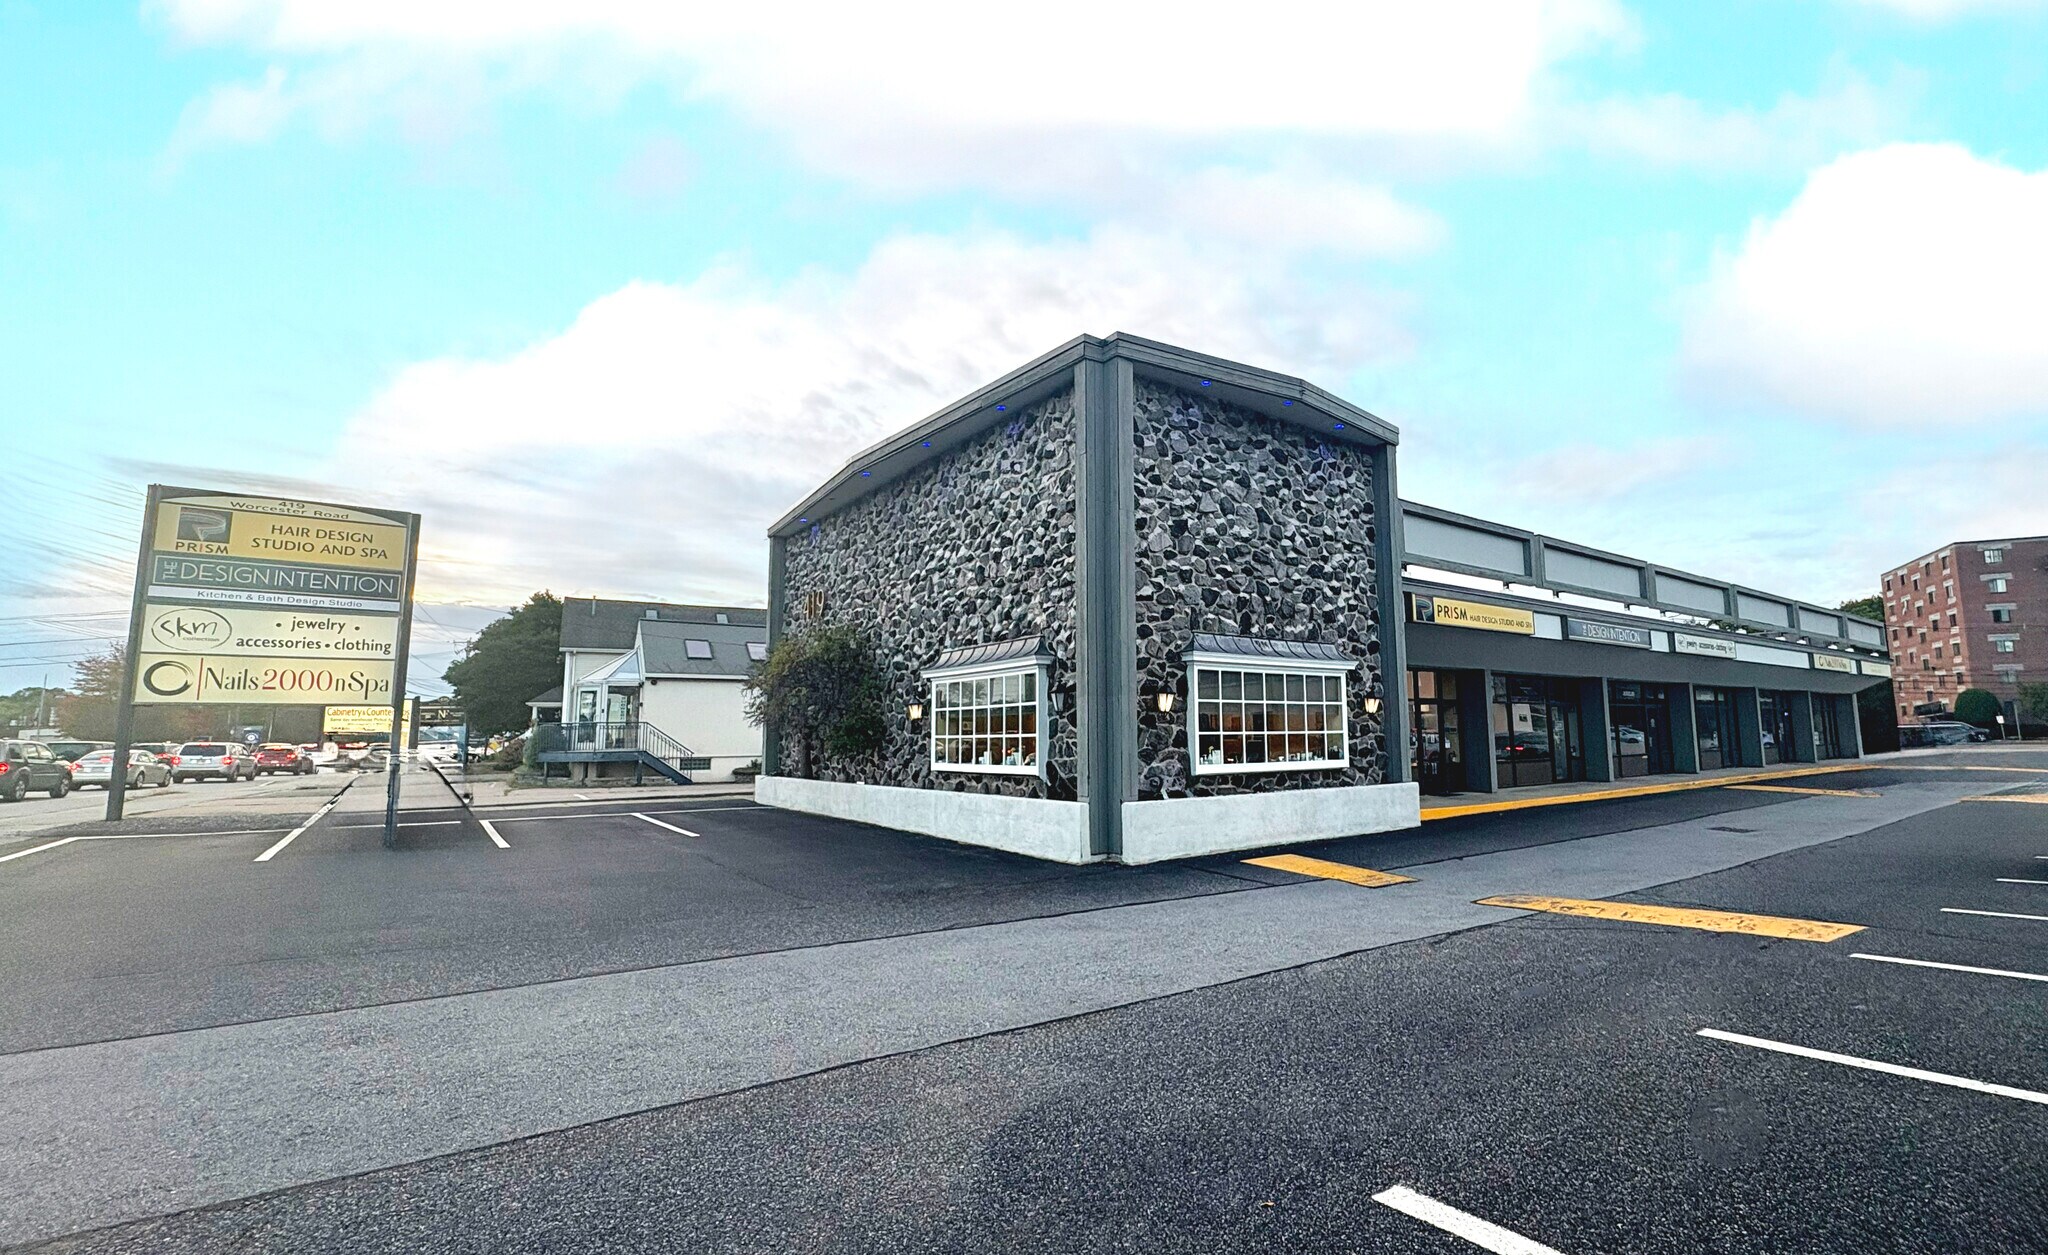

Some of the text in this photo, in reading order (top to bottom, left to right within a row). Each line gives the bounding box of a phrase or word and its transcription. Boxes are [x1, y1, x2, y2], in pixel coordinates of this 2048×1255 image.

[230, 501, 350, 520] Worcester Road
[278, 500, 305, 509] 419
[271, 524, 374, 544] HAIR DESIGN
[175, 541, 229, 554] PRISM
[251, 537, 388, 560] STUDIO AND SPA
[162, 561, 178, 579] THE
[197, 590, 242, 600] Kitchen
[257, 594, 284, 602] Bath
[287, 596, 325, 606] Design
[328, 599, 363, 608] Studio
[803, 589, 825, 621] 419
[1436, 604, 1468, 621] PRISM
[290, 616, 346, 634] jewelry
[236, 637, 392, 655] accessories clothing
